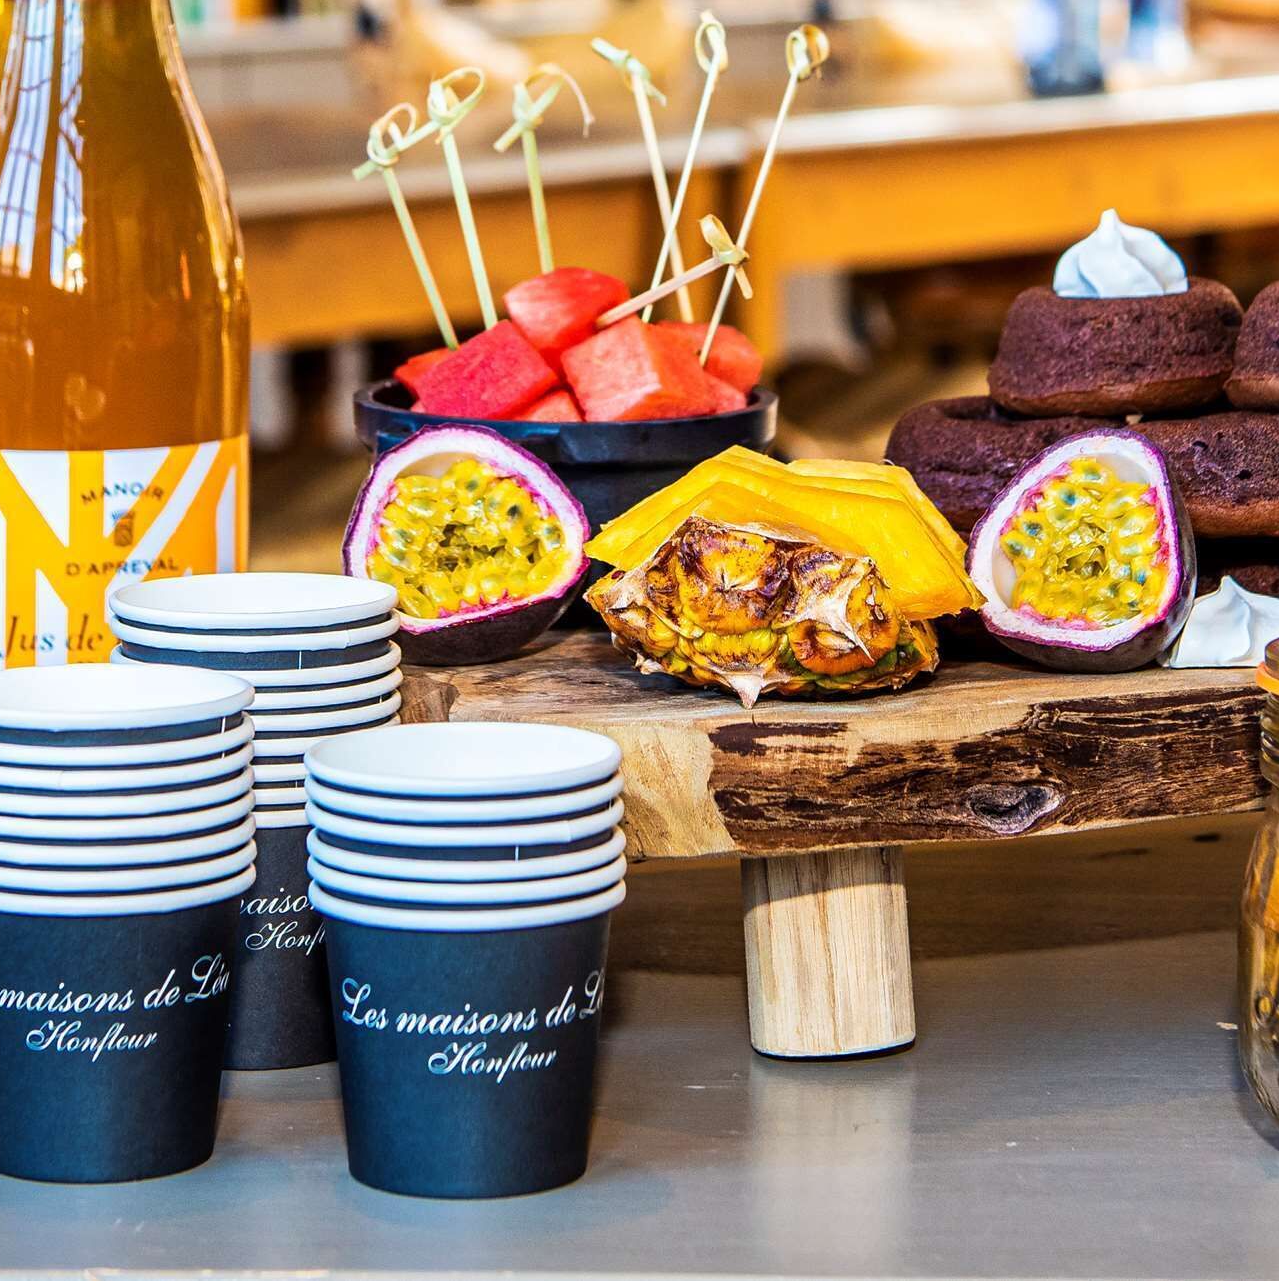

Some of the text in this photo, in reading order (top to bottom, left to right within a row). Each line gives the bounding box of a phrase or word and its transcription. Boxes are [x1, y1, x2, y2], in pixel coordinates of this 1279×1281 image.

[81, 482, 164, 504] MANOIR
[66, 614, 103, 651] de
[143, 968, 180, 1009] de
[341, 977, 389, 1031] Les
[396, 1003, 538, 1035] maisons
[545, 985, 576, 1029] de
[26, 1020, 158, 1062] Honfleur
[428, 1042, 558, 1083] Honfleur
